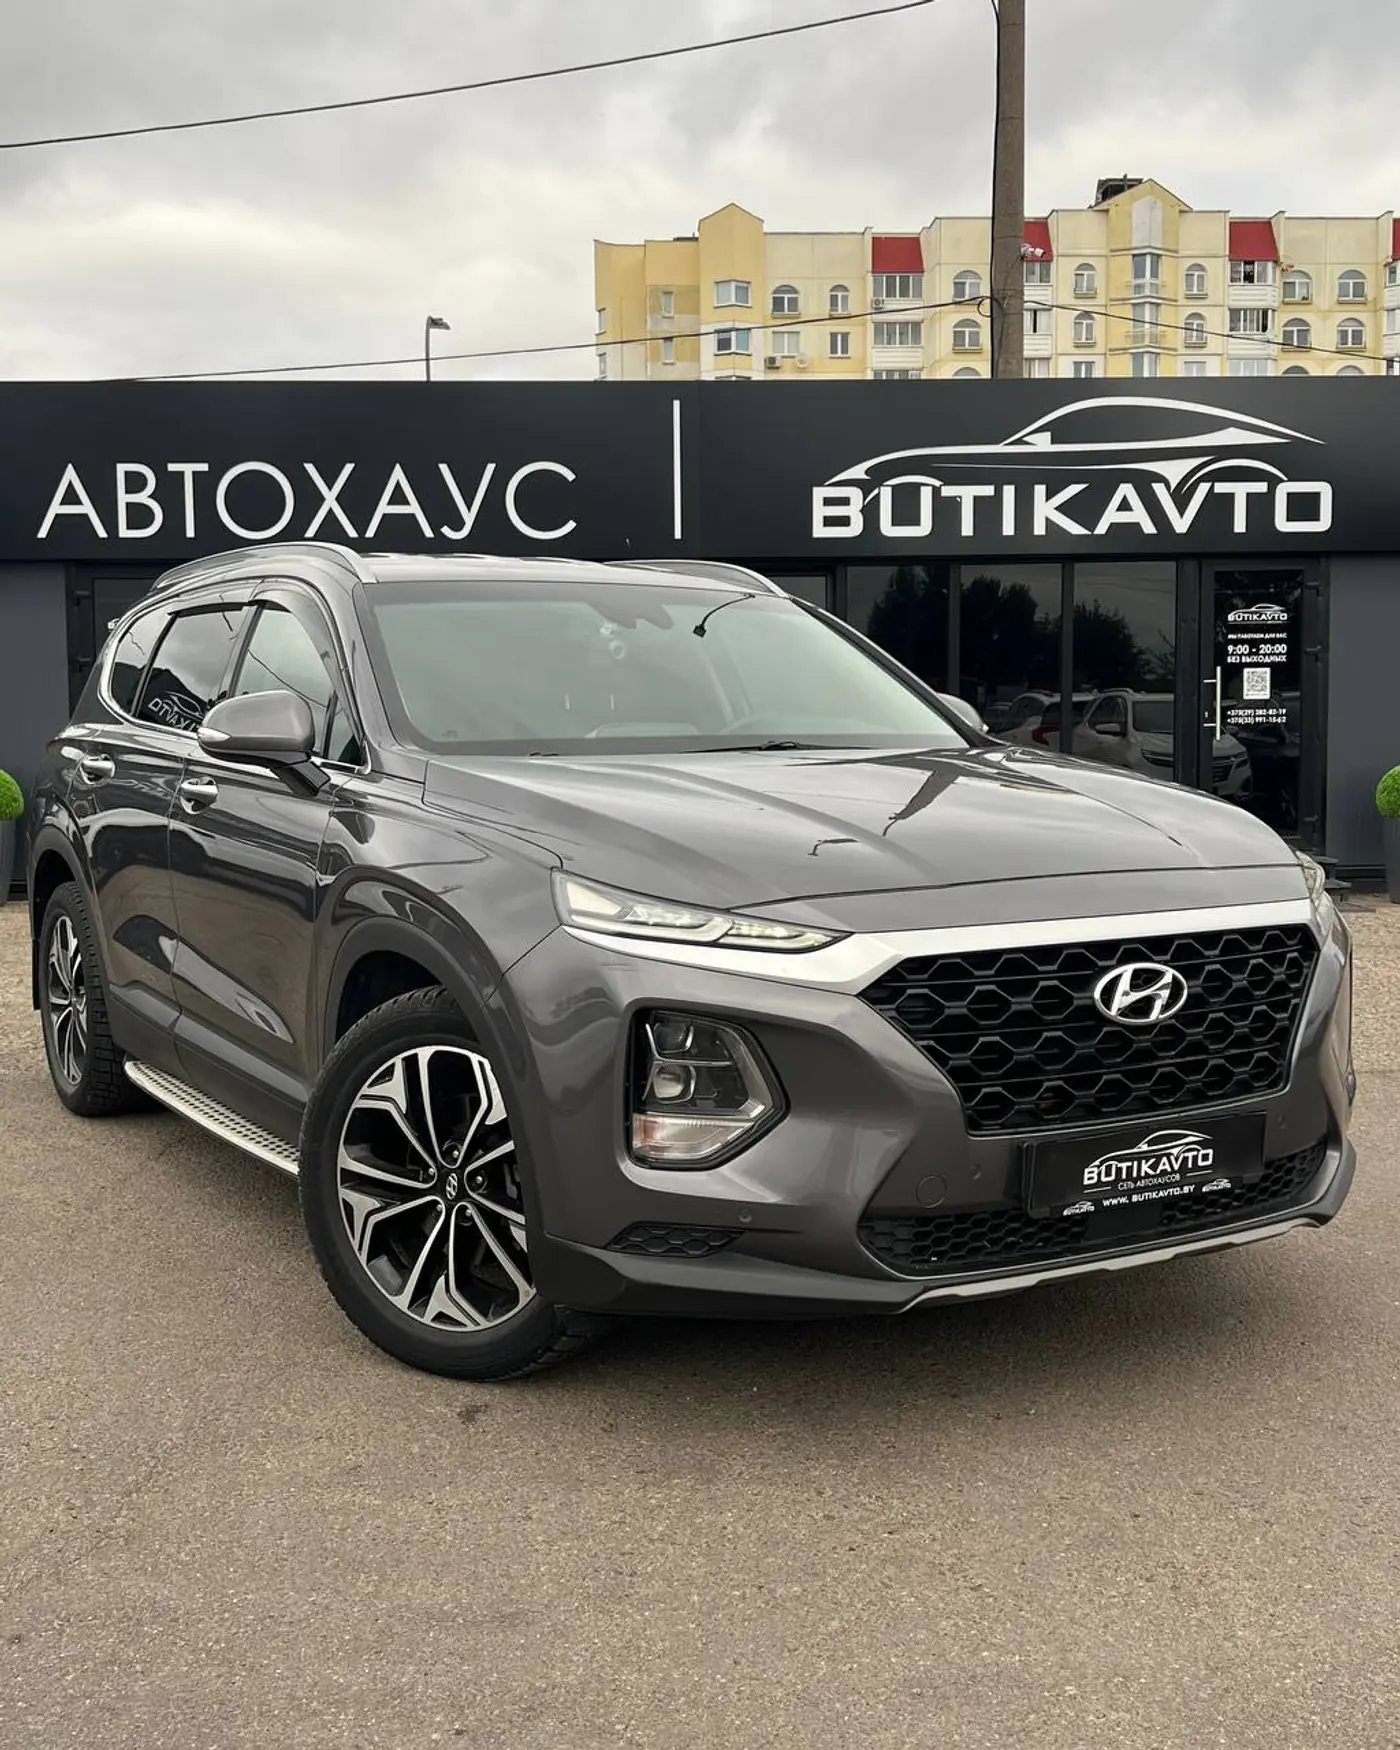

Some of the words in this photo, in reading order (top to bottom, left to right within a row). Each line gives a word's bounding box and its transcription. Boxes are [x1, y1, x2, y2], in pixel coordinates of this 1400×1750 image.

[36, 460, 578, 540] АВТОХАУС
[811, 481, 1333, 538] BUTIKAVTO
[1227, 612, 1288, 622] BUTIKAVTO
[1227, 644, 1250, 655] 9:00
[1259, 644, 1288, 654] 20:00
[1227, 655, 1240, 663] БЕЗ
[1241, 654, 1287, 663] ВЫХОДНЫХ
[1083, 1148, 1213, 1186] BUTIKAVTO
[1117, 1180, 1135, 1191] СЕТЬ
[1136, 1173, 1181, 1188] АВТОХАУСОВ
[1131, 1184, 1196, 1203] BUTIKAVTO.BY
